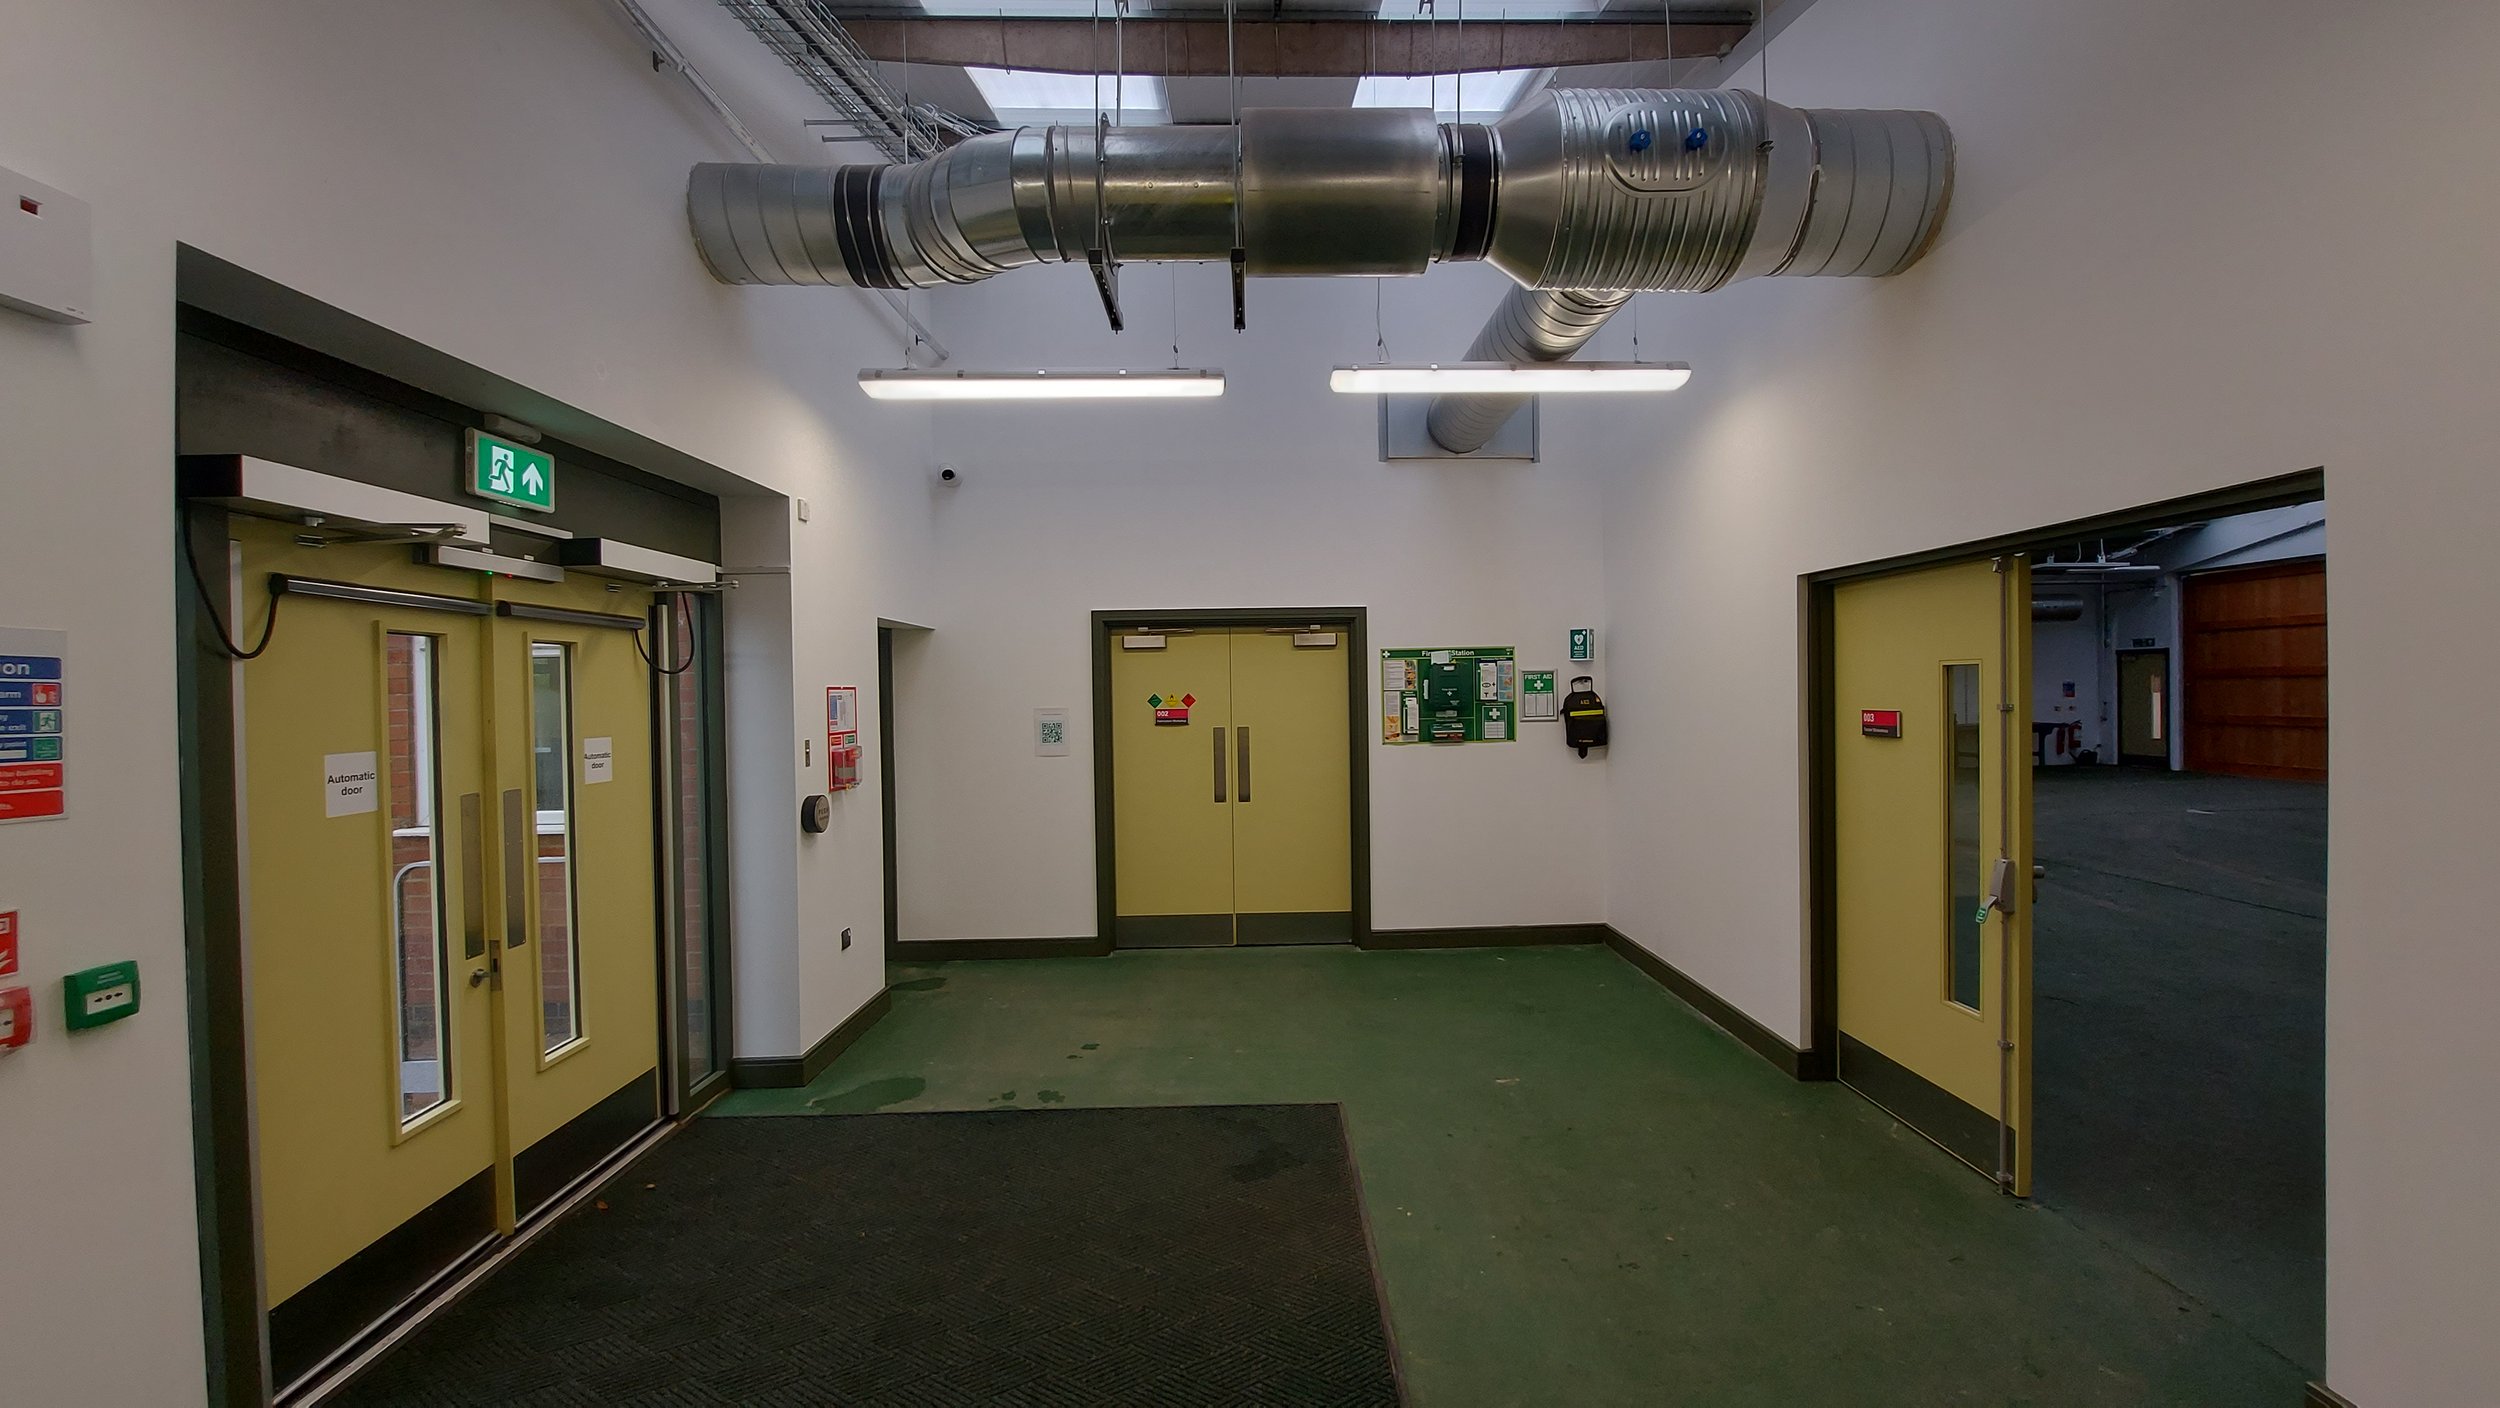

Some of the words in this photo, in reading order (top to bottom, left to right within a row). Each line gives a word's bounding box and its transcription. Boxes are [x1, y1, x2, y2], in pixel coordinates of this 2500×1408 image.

[583, 752, 612, 760] Automatic
[591, 761, 605, 769] door
[327, 770, 376, 785] Automatic
[340, 785, 364, 797] door
